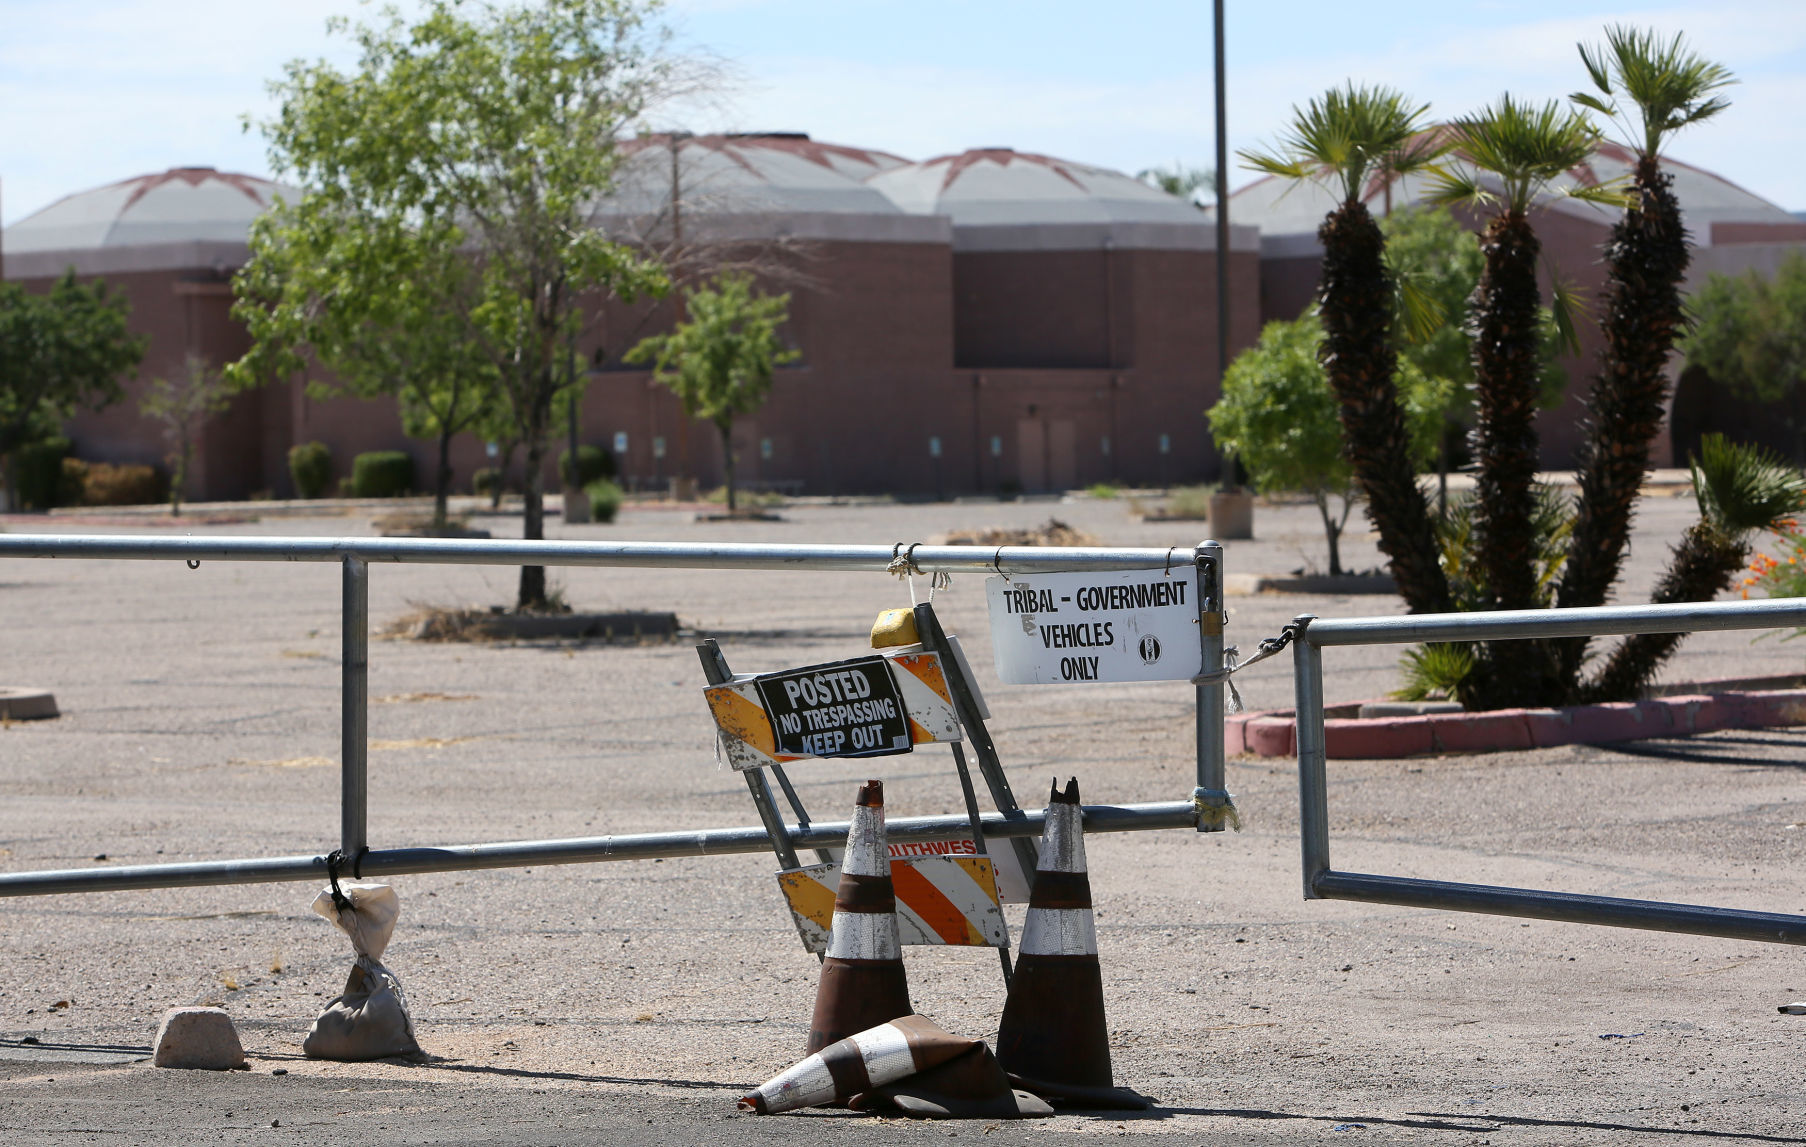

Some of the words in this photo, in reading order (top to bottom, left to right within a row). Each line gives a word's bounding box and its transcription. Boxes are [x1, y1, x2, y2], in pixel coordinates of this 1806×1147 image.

[1003, 589, 1058, 613] TRIBAL
[1076, 581, 1188, 611] GOVERNMENT
[1040, 621, 1114, 649] VEHICLES
[1060, 656, 1099, 681] ONLY
[783, 669, 871, 709] POSTED
[779, 712, 801, 735] NO
[803, 697, 896, 731] TRESPASSING
[802, 730, 846, 755] KEEP
[851, 725, 884, 749] OUT
[888, 840, 977, 857] OUTHWES
